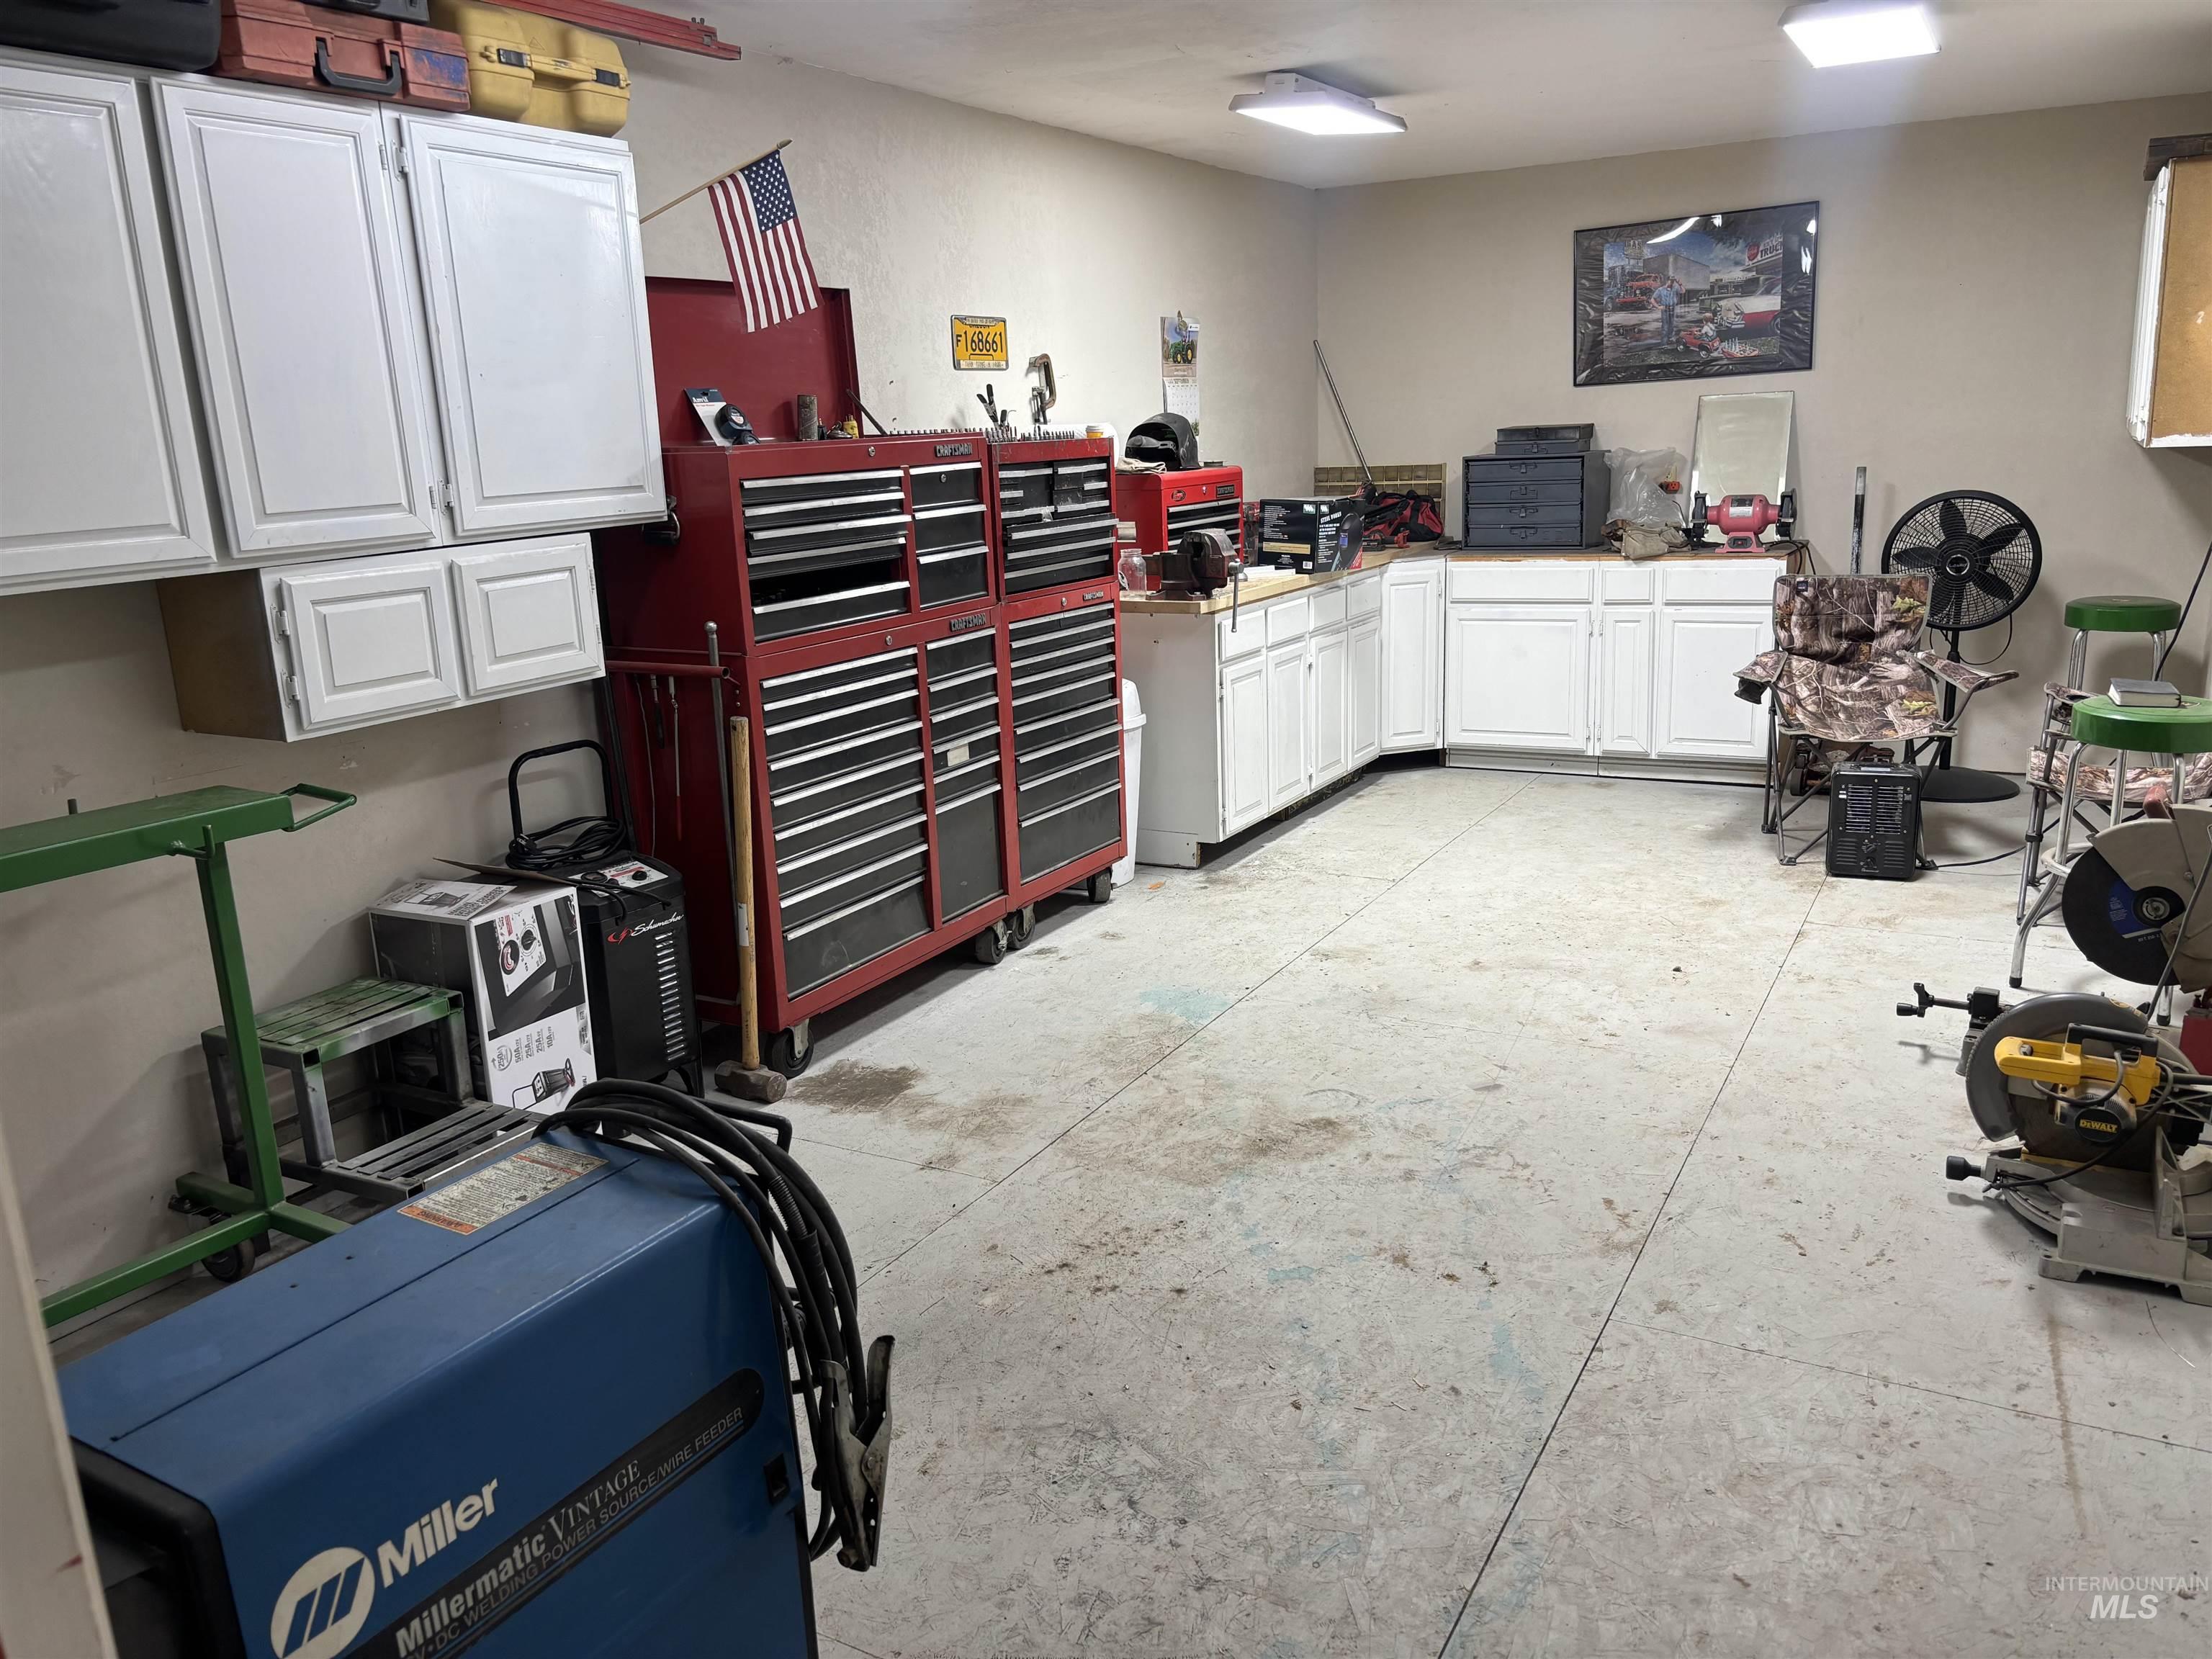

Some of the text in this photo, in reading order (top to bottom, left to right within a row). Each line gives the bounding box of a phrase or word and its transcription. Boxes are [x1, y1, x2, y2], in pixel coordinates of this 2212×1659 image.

[935, 443, 973, 457] CRAFTSMAN
[950, 613, 986, 631] CRAFTSMAN
[631, 912, 684, 937] Schumacher
[377, 1478, 498, 1588] Miller
[464, 1562, 539, 1627] WELDING
[541, 1519, 597, 1569] POWER
[600, 1443, 693, 1525] SOURCE/WIRE
[694, 1407, 743, 1452] FEEDER
[395, 1460, 641, 1659] Millermatic VINTAGE
